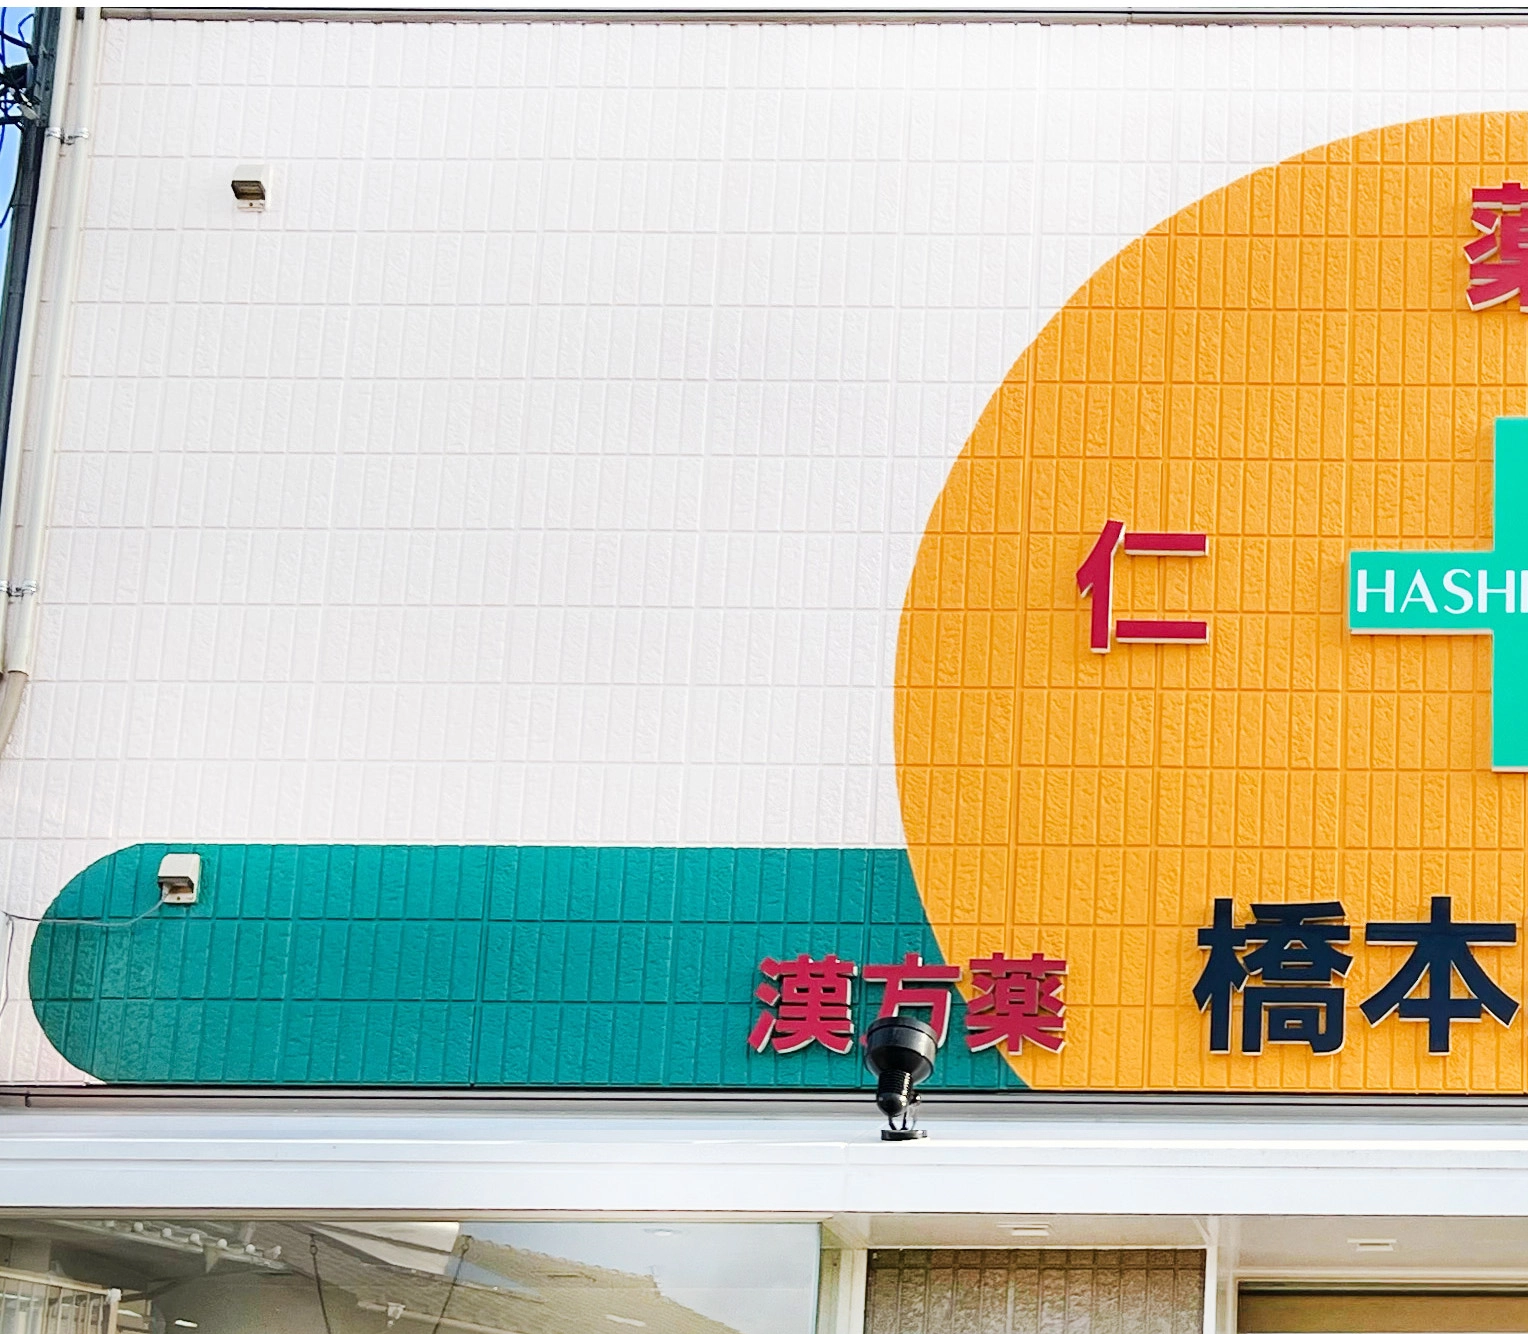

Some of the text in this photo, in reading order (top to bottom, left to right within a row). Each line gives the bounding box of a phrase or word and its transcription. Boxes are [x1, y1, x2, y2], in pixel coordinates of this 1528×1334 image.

[1075, 520, 1210, 653] 仁
[748, 952, 1068, 1056] 漢方薬
